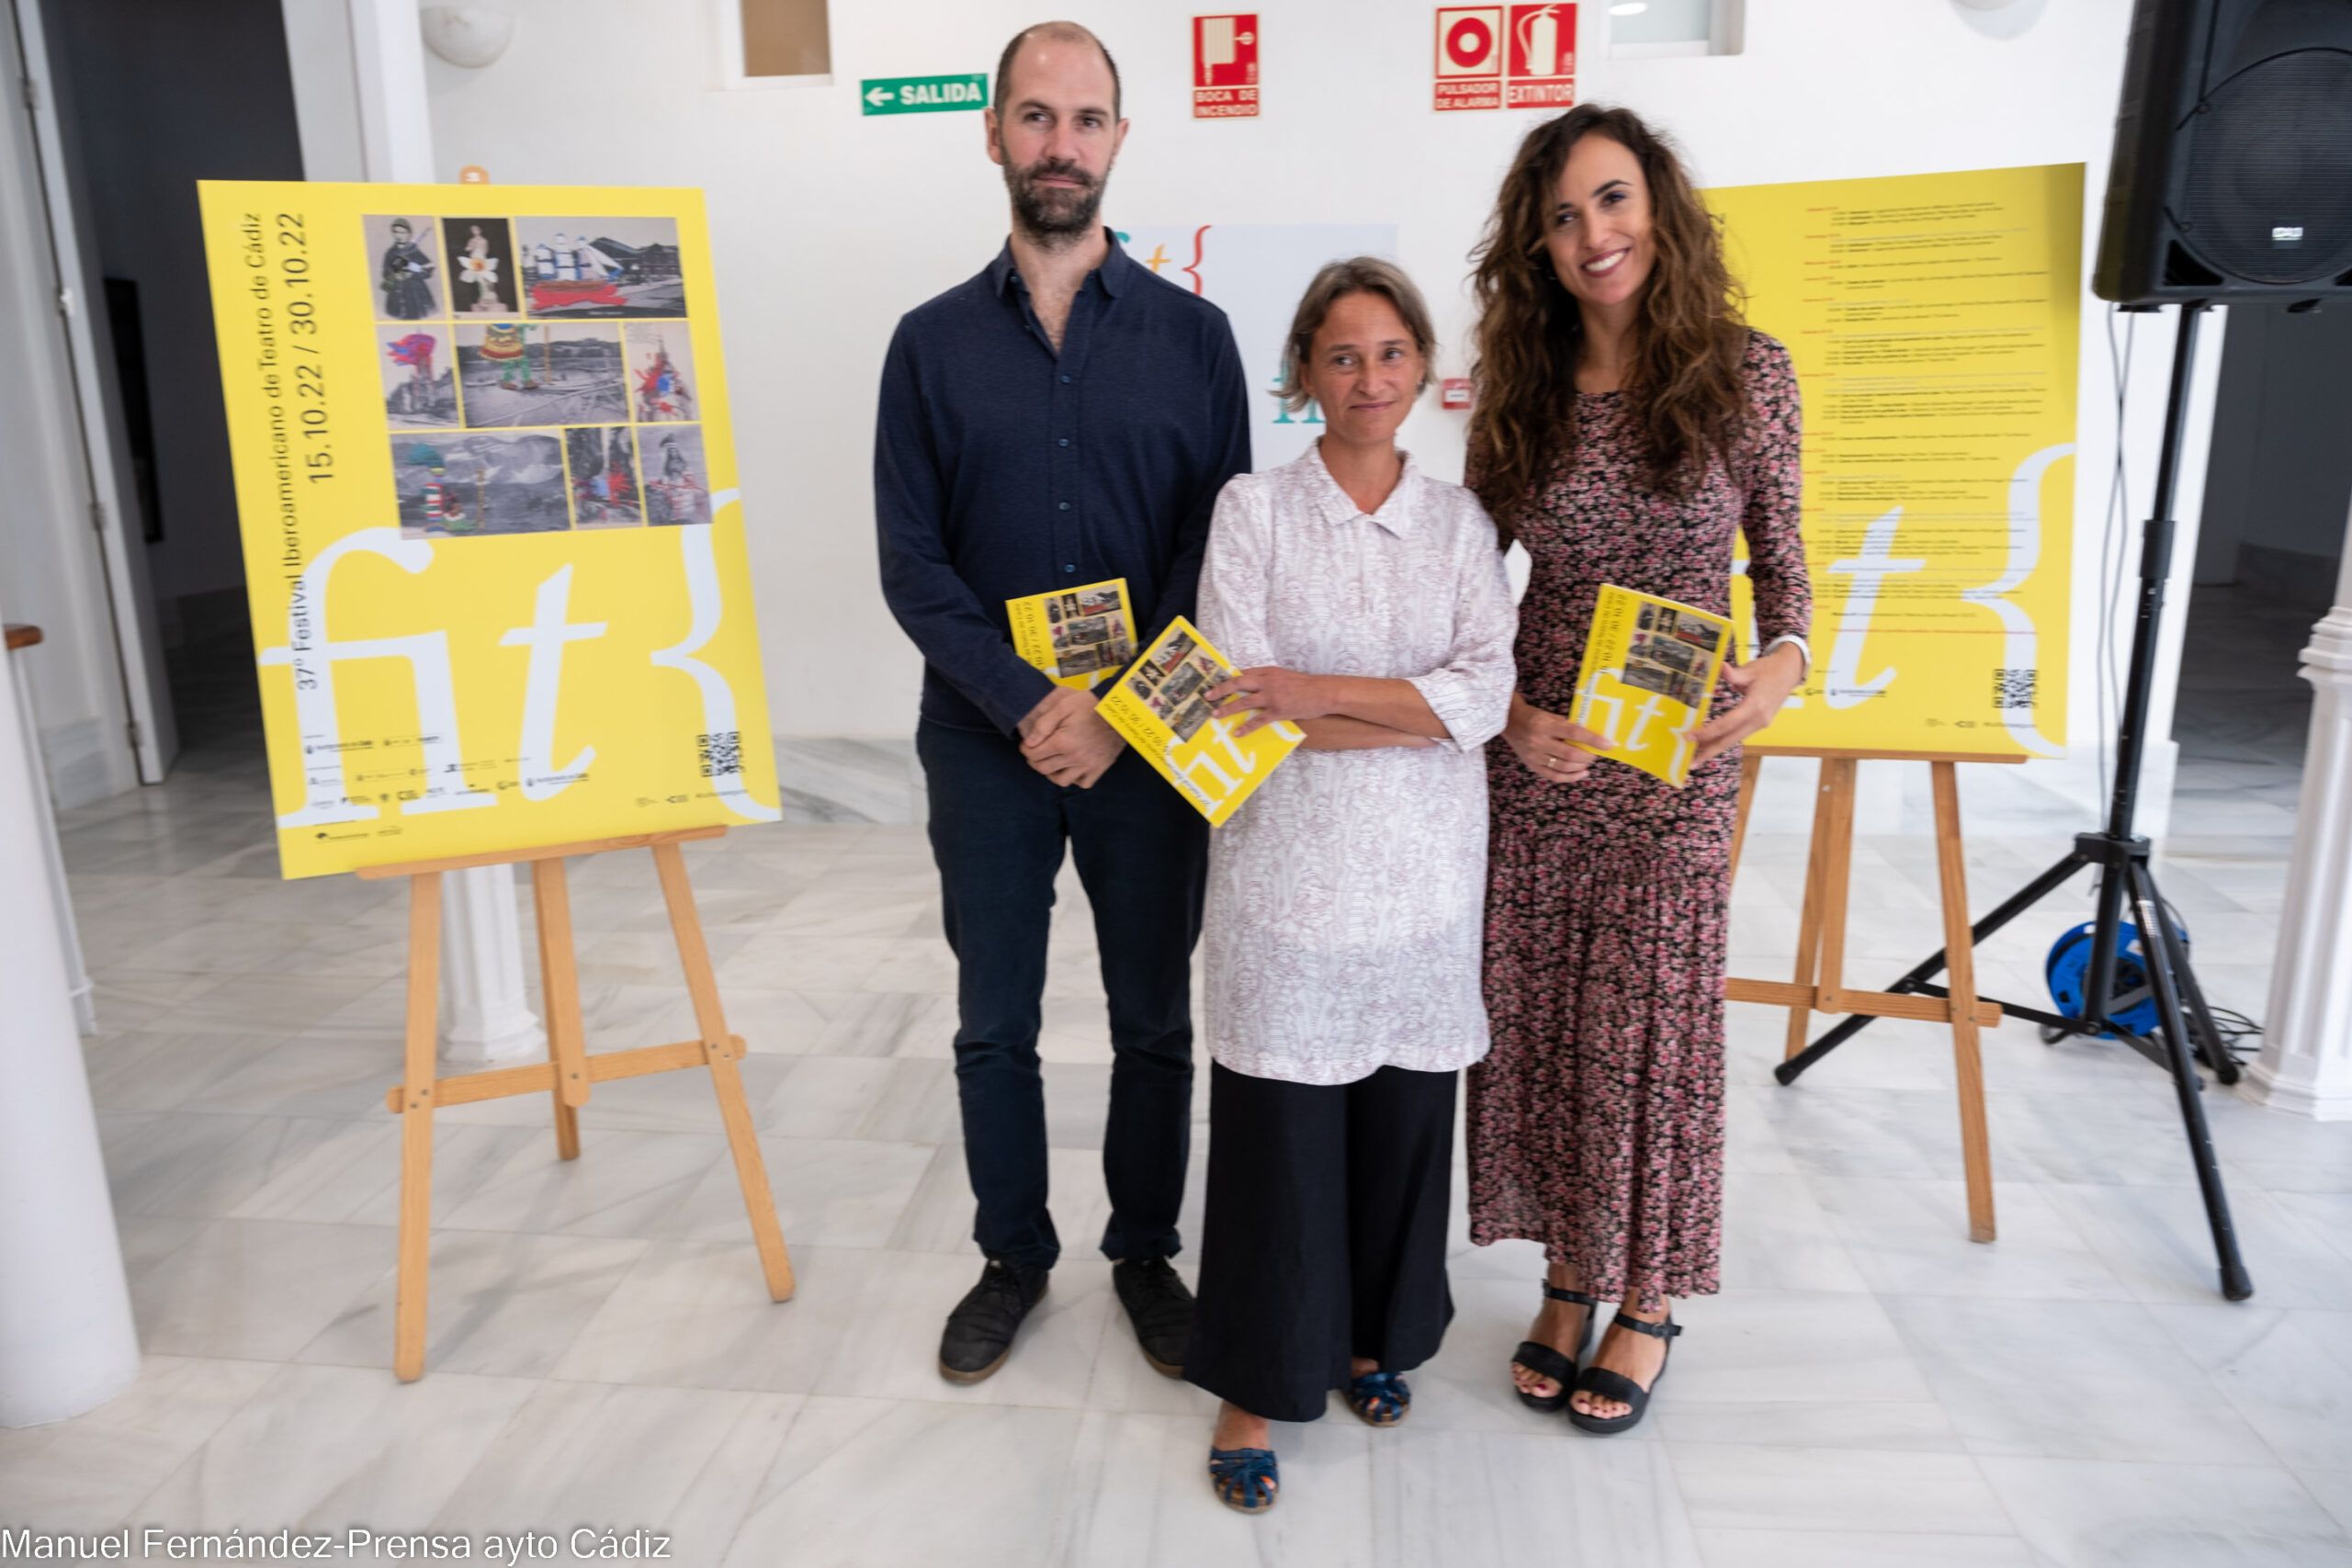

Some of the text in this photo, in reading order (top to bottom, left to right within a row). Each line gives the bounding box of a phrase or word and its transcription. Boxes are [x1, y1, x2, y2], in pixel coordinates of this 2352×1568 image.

[899, 82, 983, 105] SALIDA
[1195, 89, 1258, 102] BOCA DE
[1437, 82, 1499, 95] PULSADOR
[1508, 84, 1575, 104] EXTINTOR
[1195, 104, 1259, 116] INCENDIO
[1436, 96, 1499, 108] DE ALARMA
[240, 212, 266, 268] Cádiz
[276, 213, 318, 335] 30.10.22
[250, 276, 270, 299] de
[256, 307, 279, 371] Teatro
[261, 374, 283, 398] de
[294, 365, 334, 484] 15.10.22
[267, 405, 303, 567] Iberoamericano
[283, 574, 312, 651] Festival
